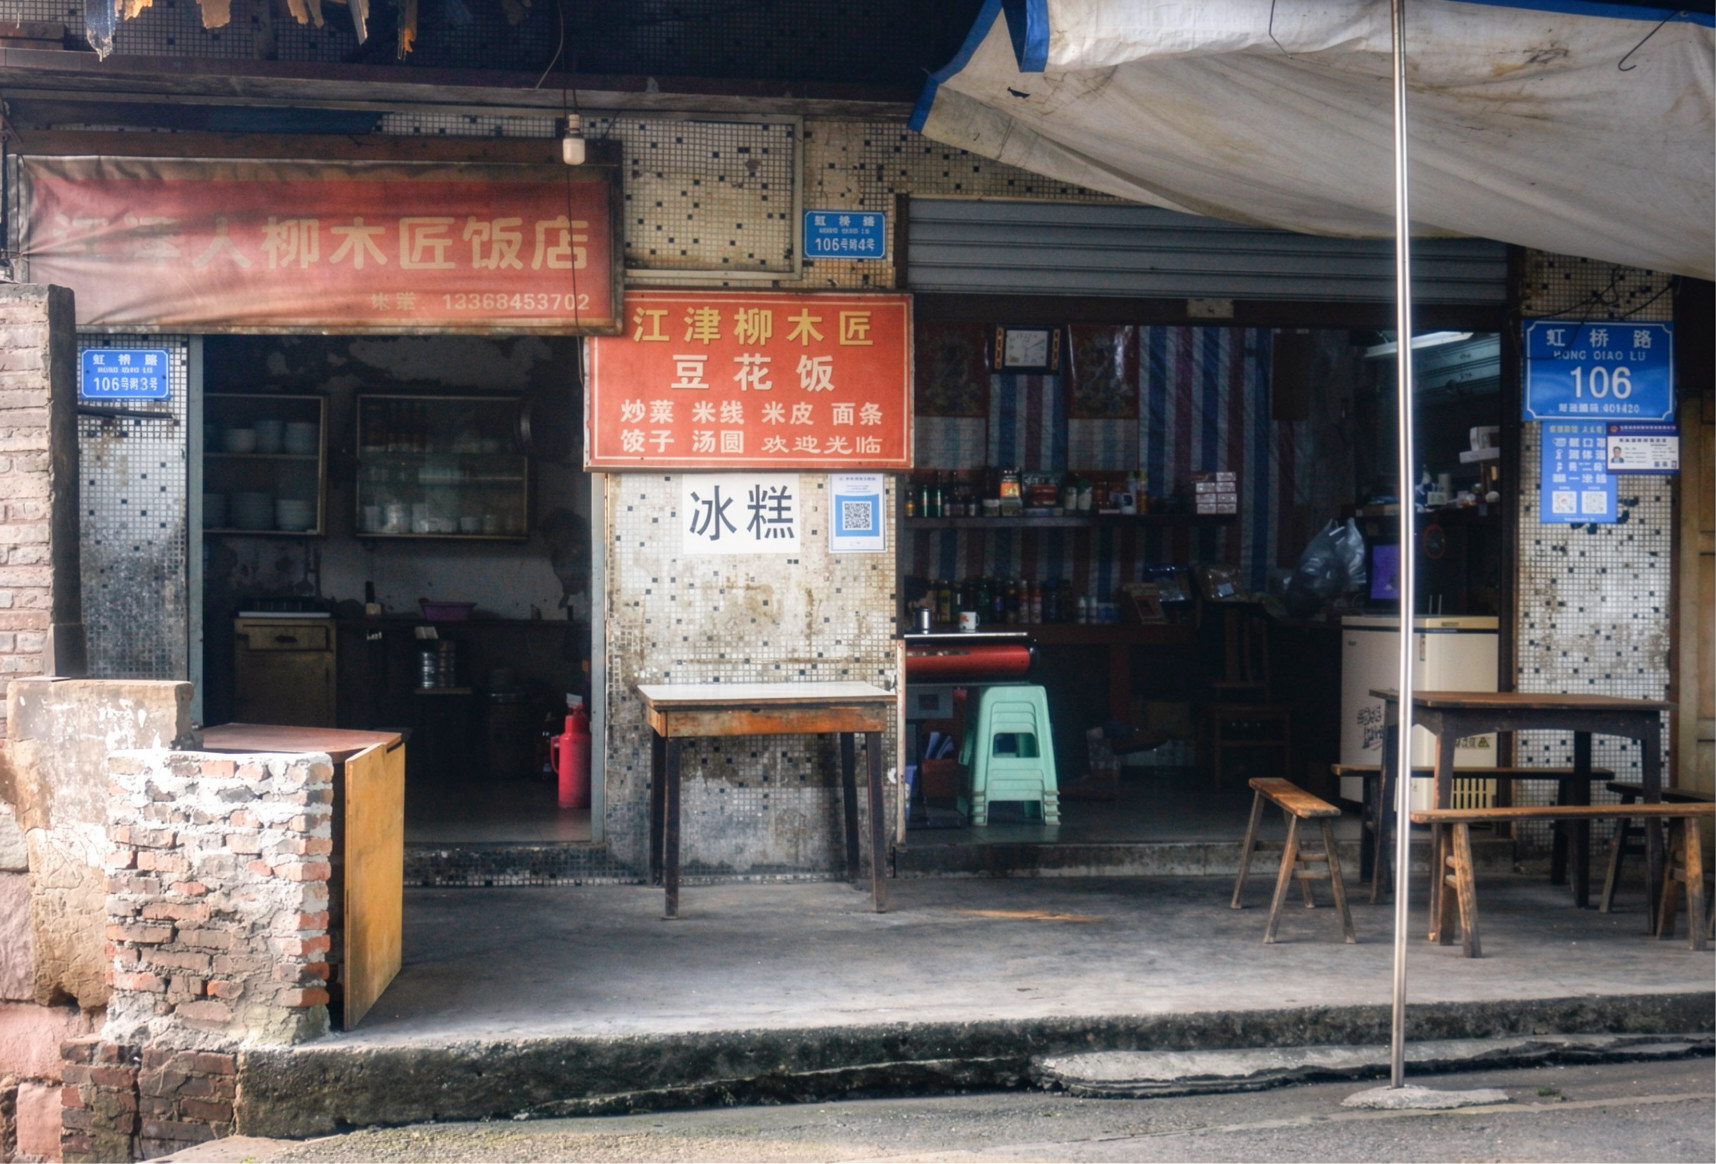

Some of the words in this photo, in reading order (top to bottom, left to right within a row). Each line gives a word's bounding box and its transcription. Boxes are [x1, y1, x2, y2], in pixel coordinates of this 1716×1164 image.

[442, 292, 590, 311] 13368453702
[633, 306, 874, 347] 江津柳木匠
[1546, 328, 1652, 349] 虹桥路
[1630, 351, 1646, 361] LU
[671, 353, 835, 392] 豆花饭
[1570, 366, 1632, 399] 106
[620, 399, 675, 424] 炒菜
[692, 400, 744, 425] 米线
[761, 401, 815, 425] 米皮
[831, 402, 883, 426] 面条
[620, 429, 675, 453] 饺子
[692, 430, 744, 453] 汤圆
[761, 434, 883, 455] 欢迎光临
[689, 484, 795, 541] 冰糕
